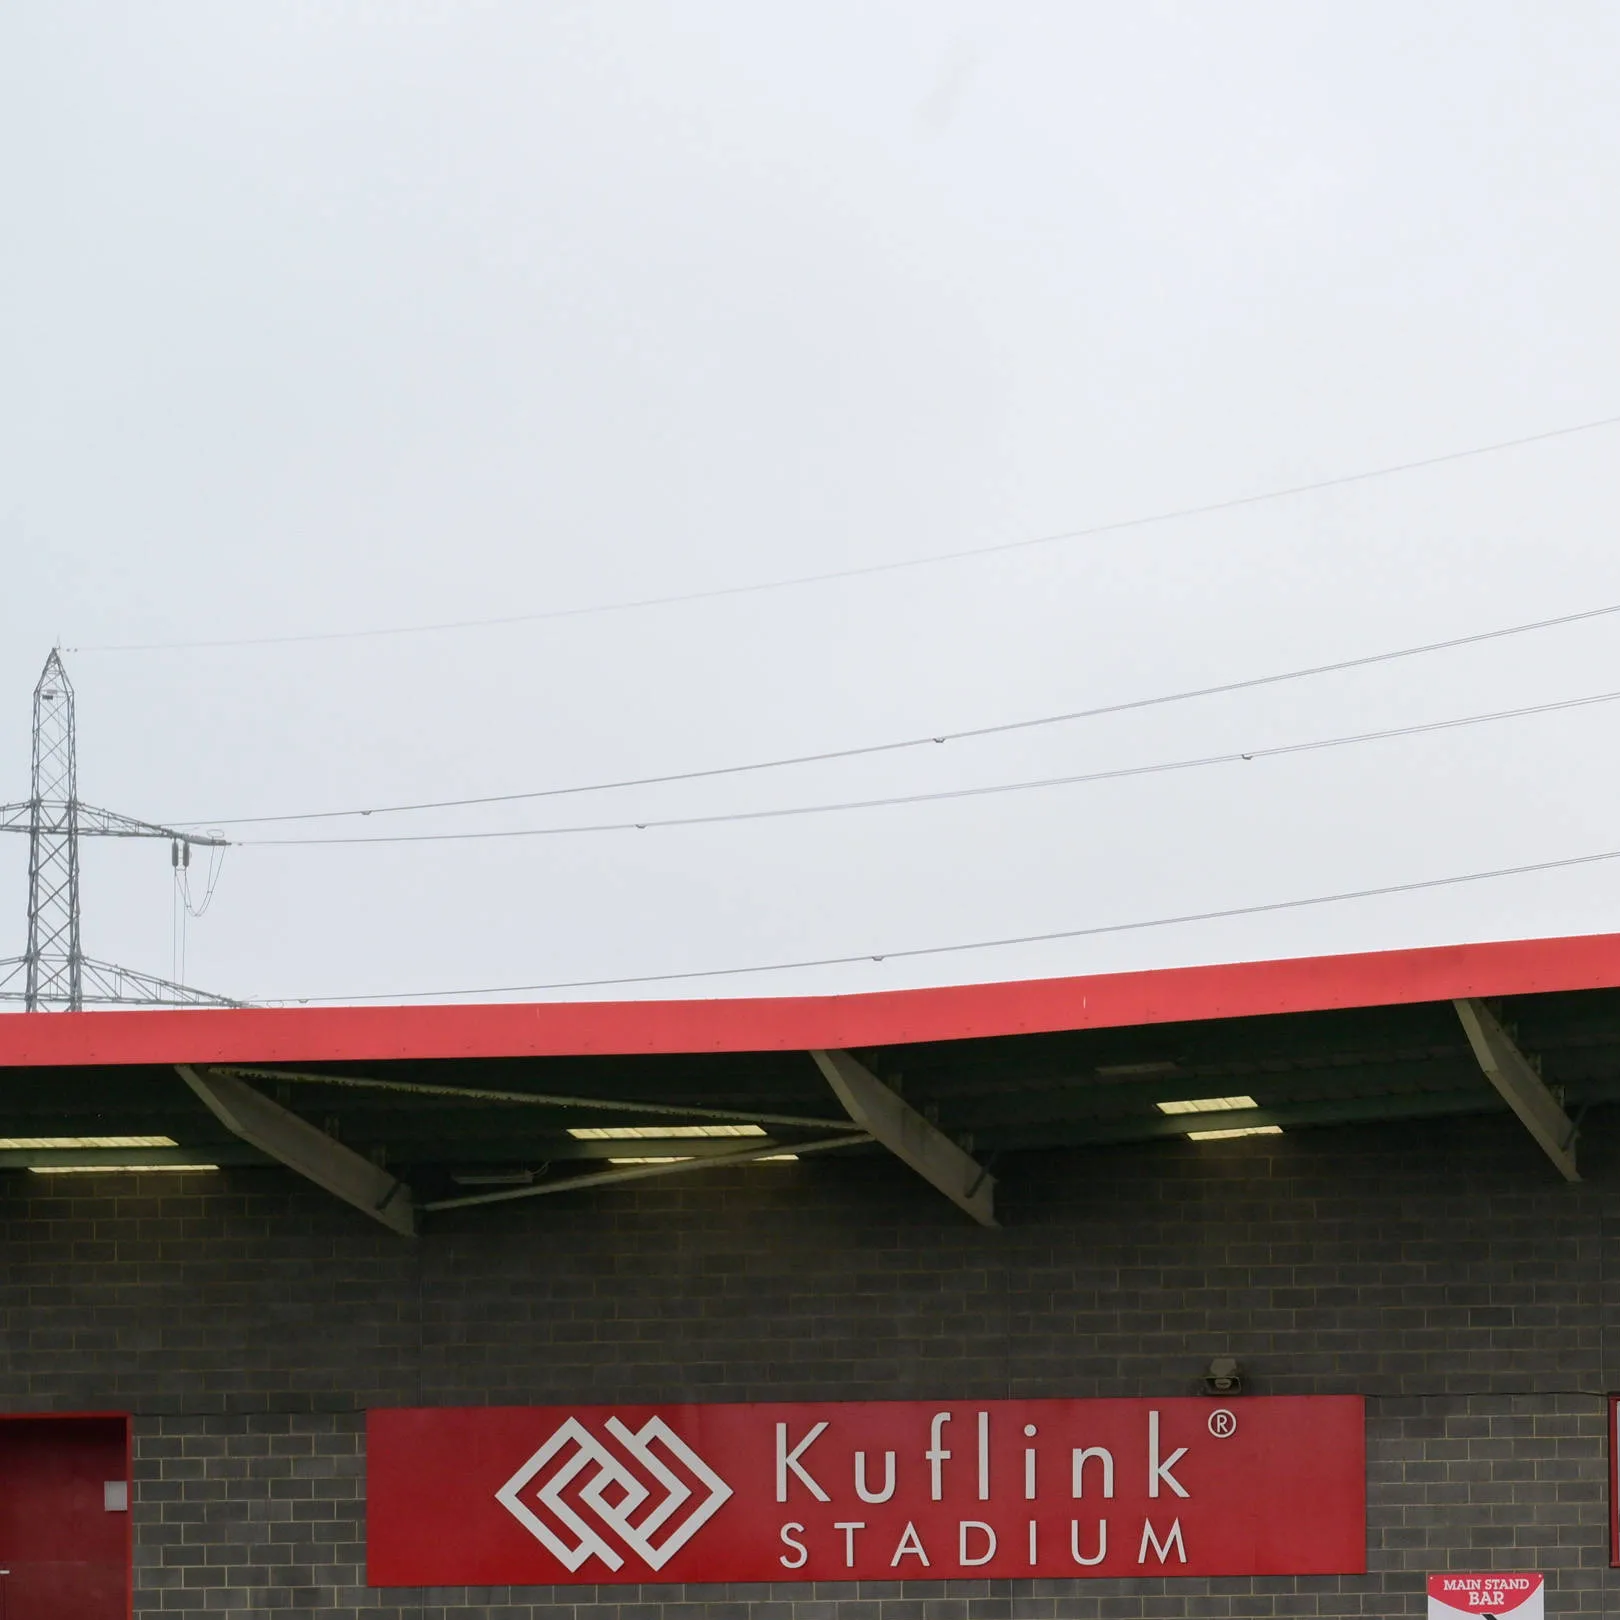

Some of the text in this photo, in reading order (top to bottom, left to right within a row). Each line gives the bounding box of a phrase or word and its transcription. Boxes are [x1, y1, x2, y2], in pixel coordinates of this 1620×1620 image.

[776, 1410, 1190, 1504] Kuflink
[779, 1517, 1187, 1569] STADIUM
[1443, 1578, 1530, 1591] MAIN STAND
[1468, 1591, 1505, 1606] BAR
